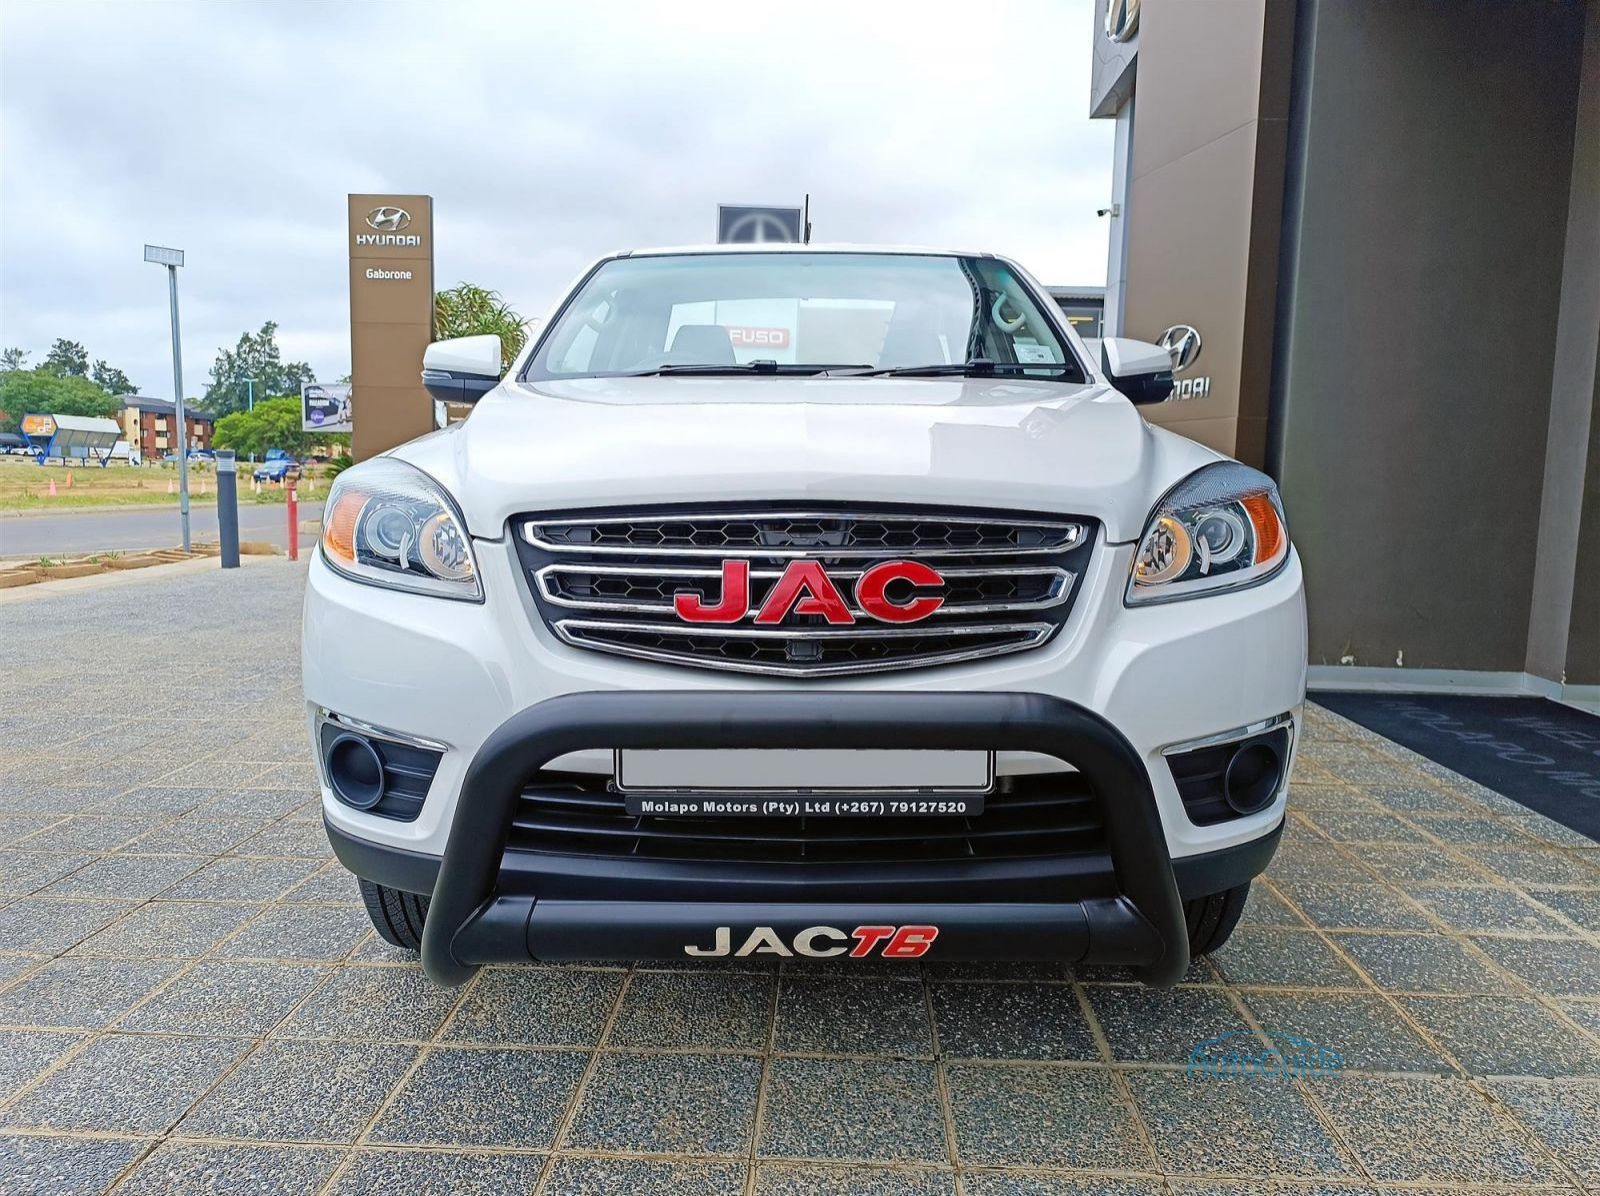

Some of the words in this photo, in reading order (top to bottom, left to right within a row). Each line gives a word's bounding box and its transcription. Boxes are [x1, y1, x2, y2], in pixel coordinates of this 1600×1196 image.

[356, 234, 421, 246] HYUNDAI
[366, 268, 412, 280] Gaborone
[729, 328, 784, 344] FUSO
[1166, 377, 1211, 402] NDAI
[673, 559, 946, 625] JAC
[641, 800, 699, 814] Molapo
[703, 800, 758, 813] Motors
[762, 800, 800, 815] (Pty)
[805, 800, 831, 813] Ltd
[835, 800, 885, 815] (+267)
[889, 800, 967, 813] 79127520
